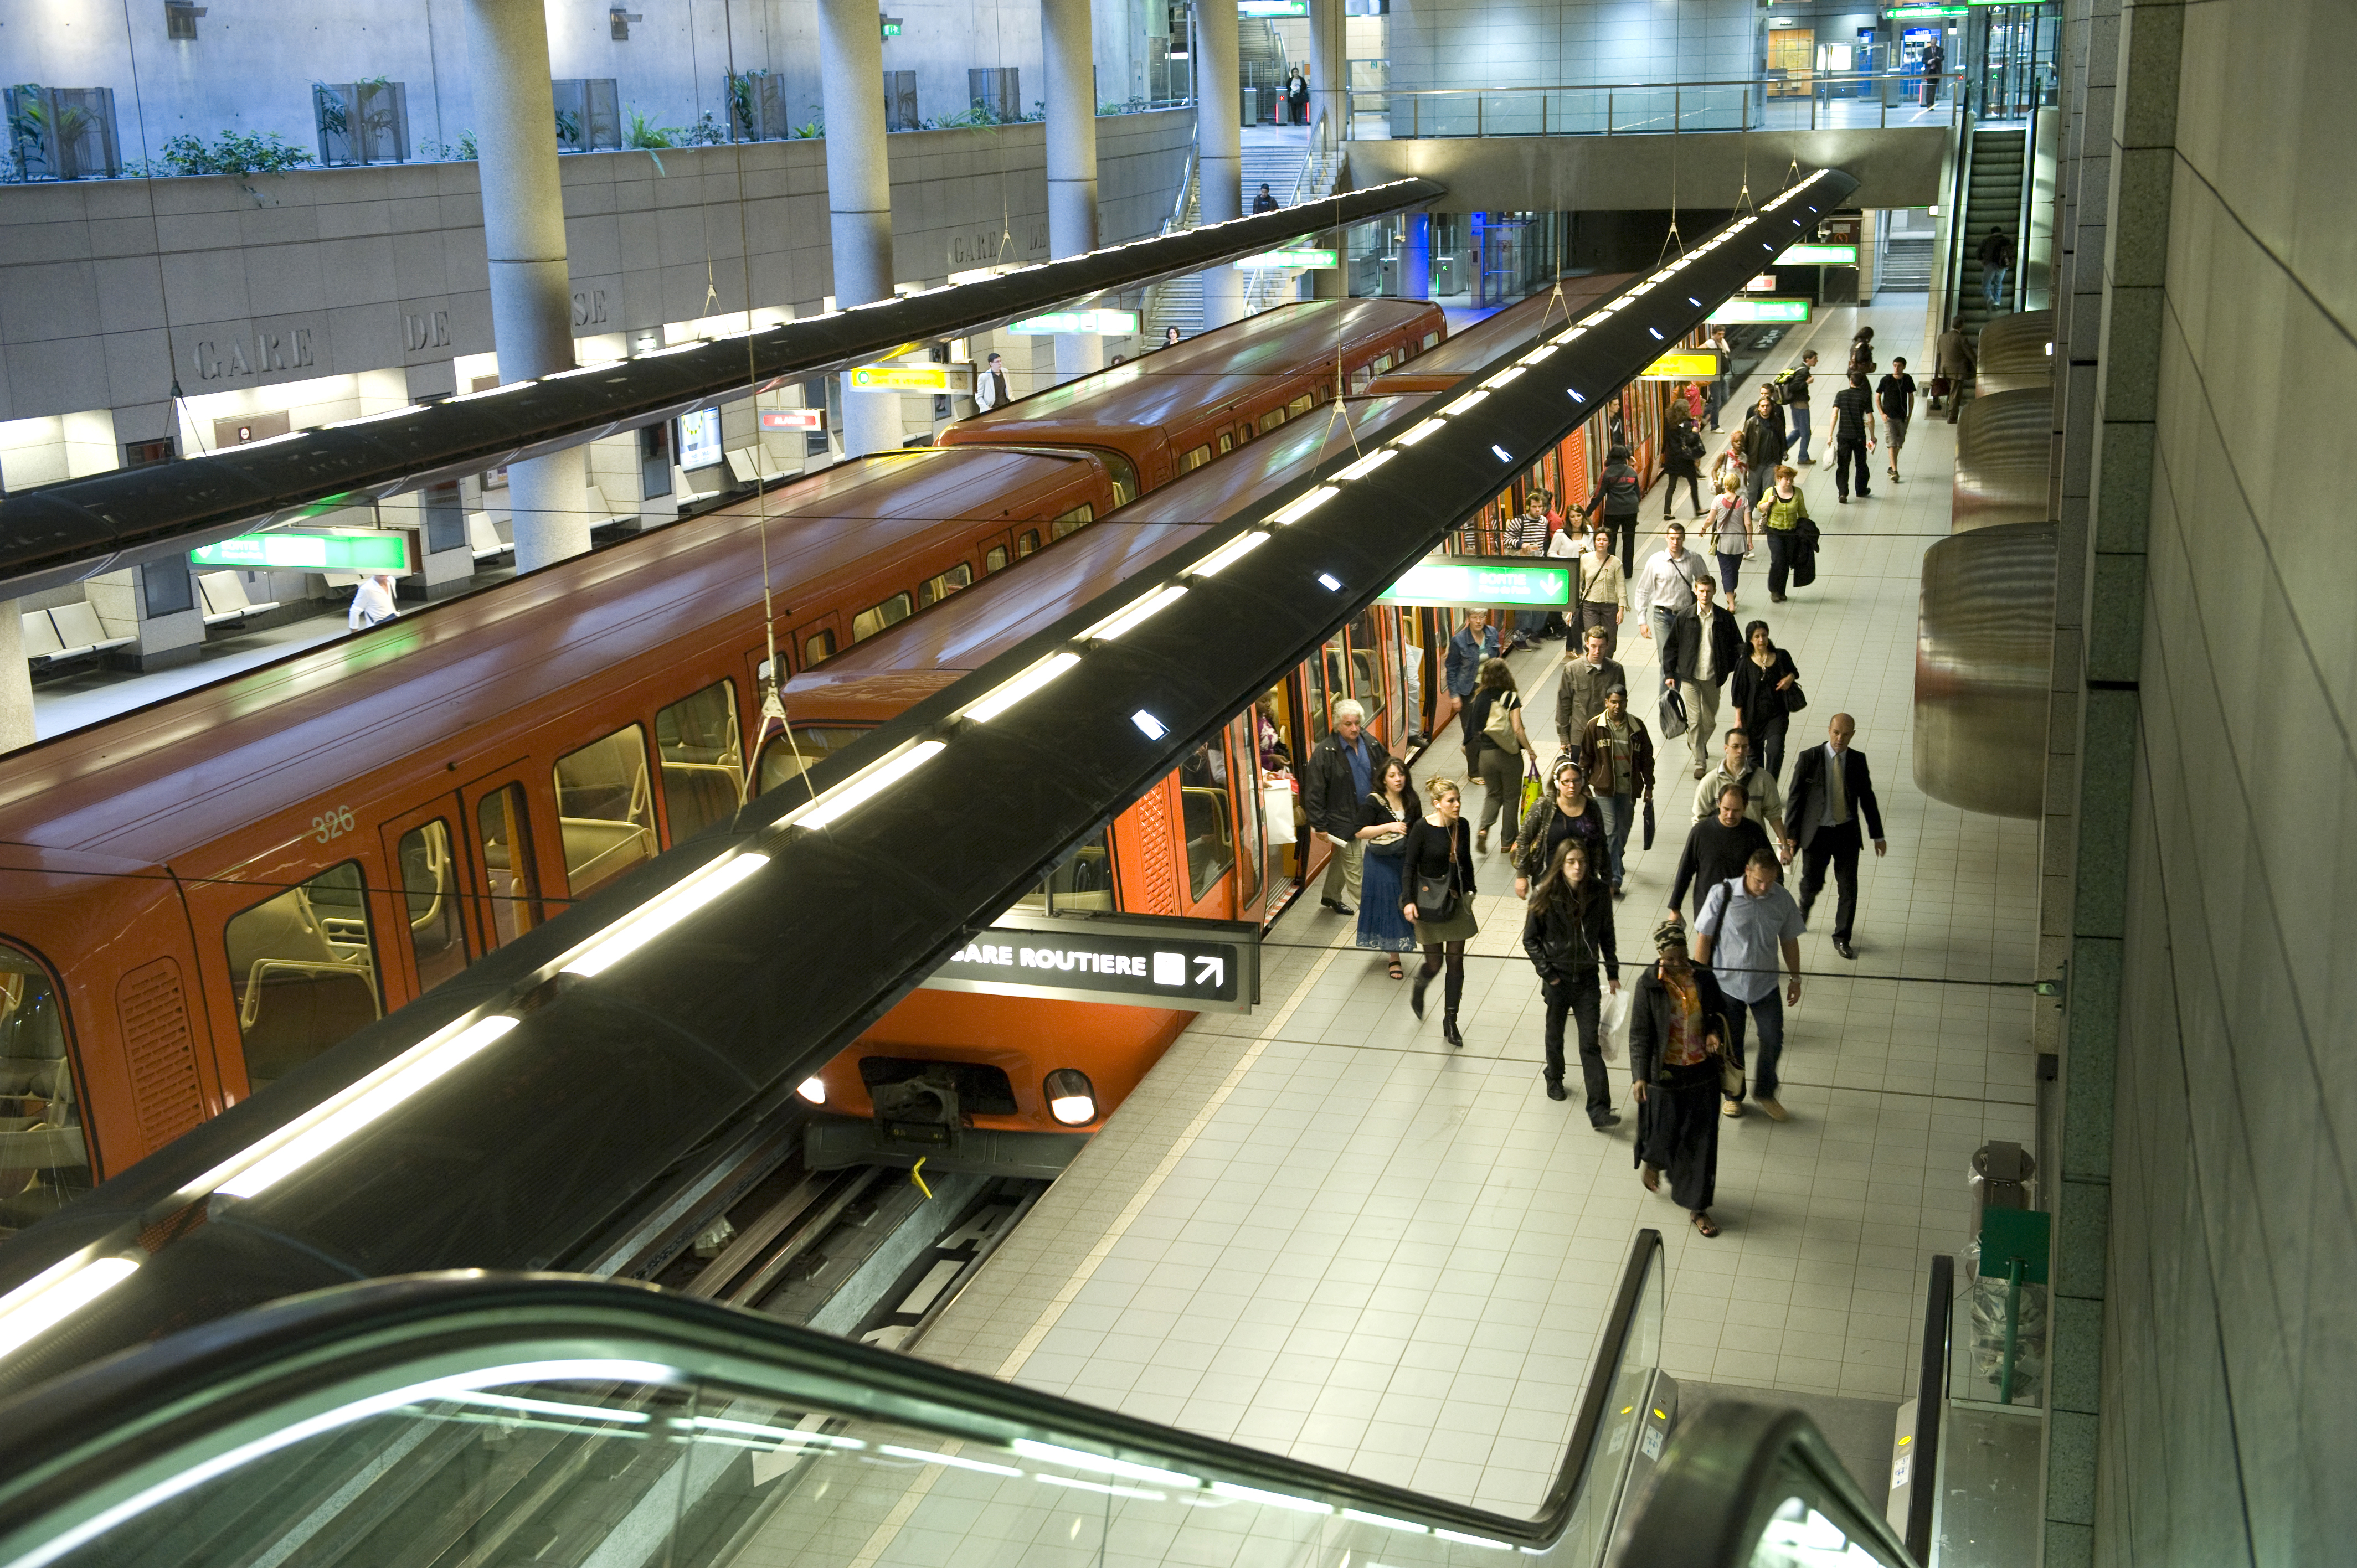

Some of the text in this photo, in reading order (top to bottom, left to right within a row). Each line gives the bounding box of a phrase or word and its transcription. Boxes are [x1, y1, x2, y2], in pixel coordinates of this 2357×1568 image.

[955, 224, 1046, 264] GARE DE
[194, 329, 313, 380] GARE
[405, 312, 451, 351] DE
[1479, 572, 1526, 585] SORTIE
[312, 804, 355, 844] 326
[1020, 947, 1147, 977] ROUTIERE
